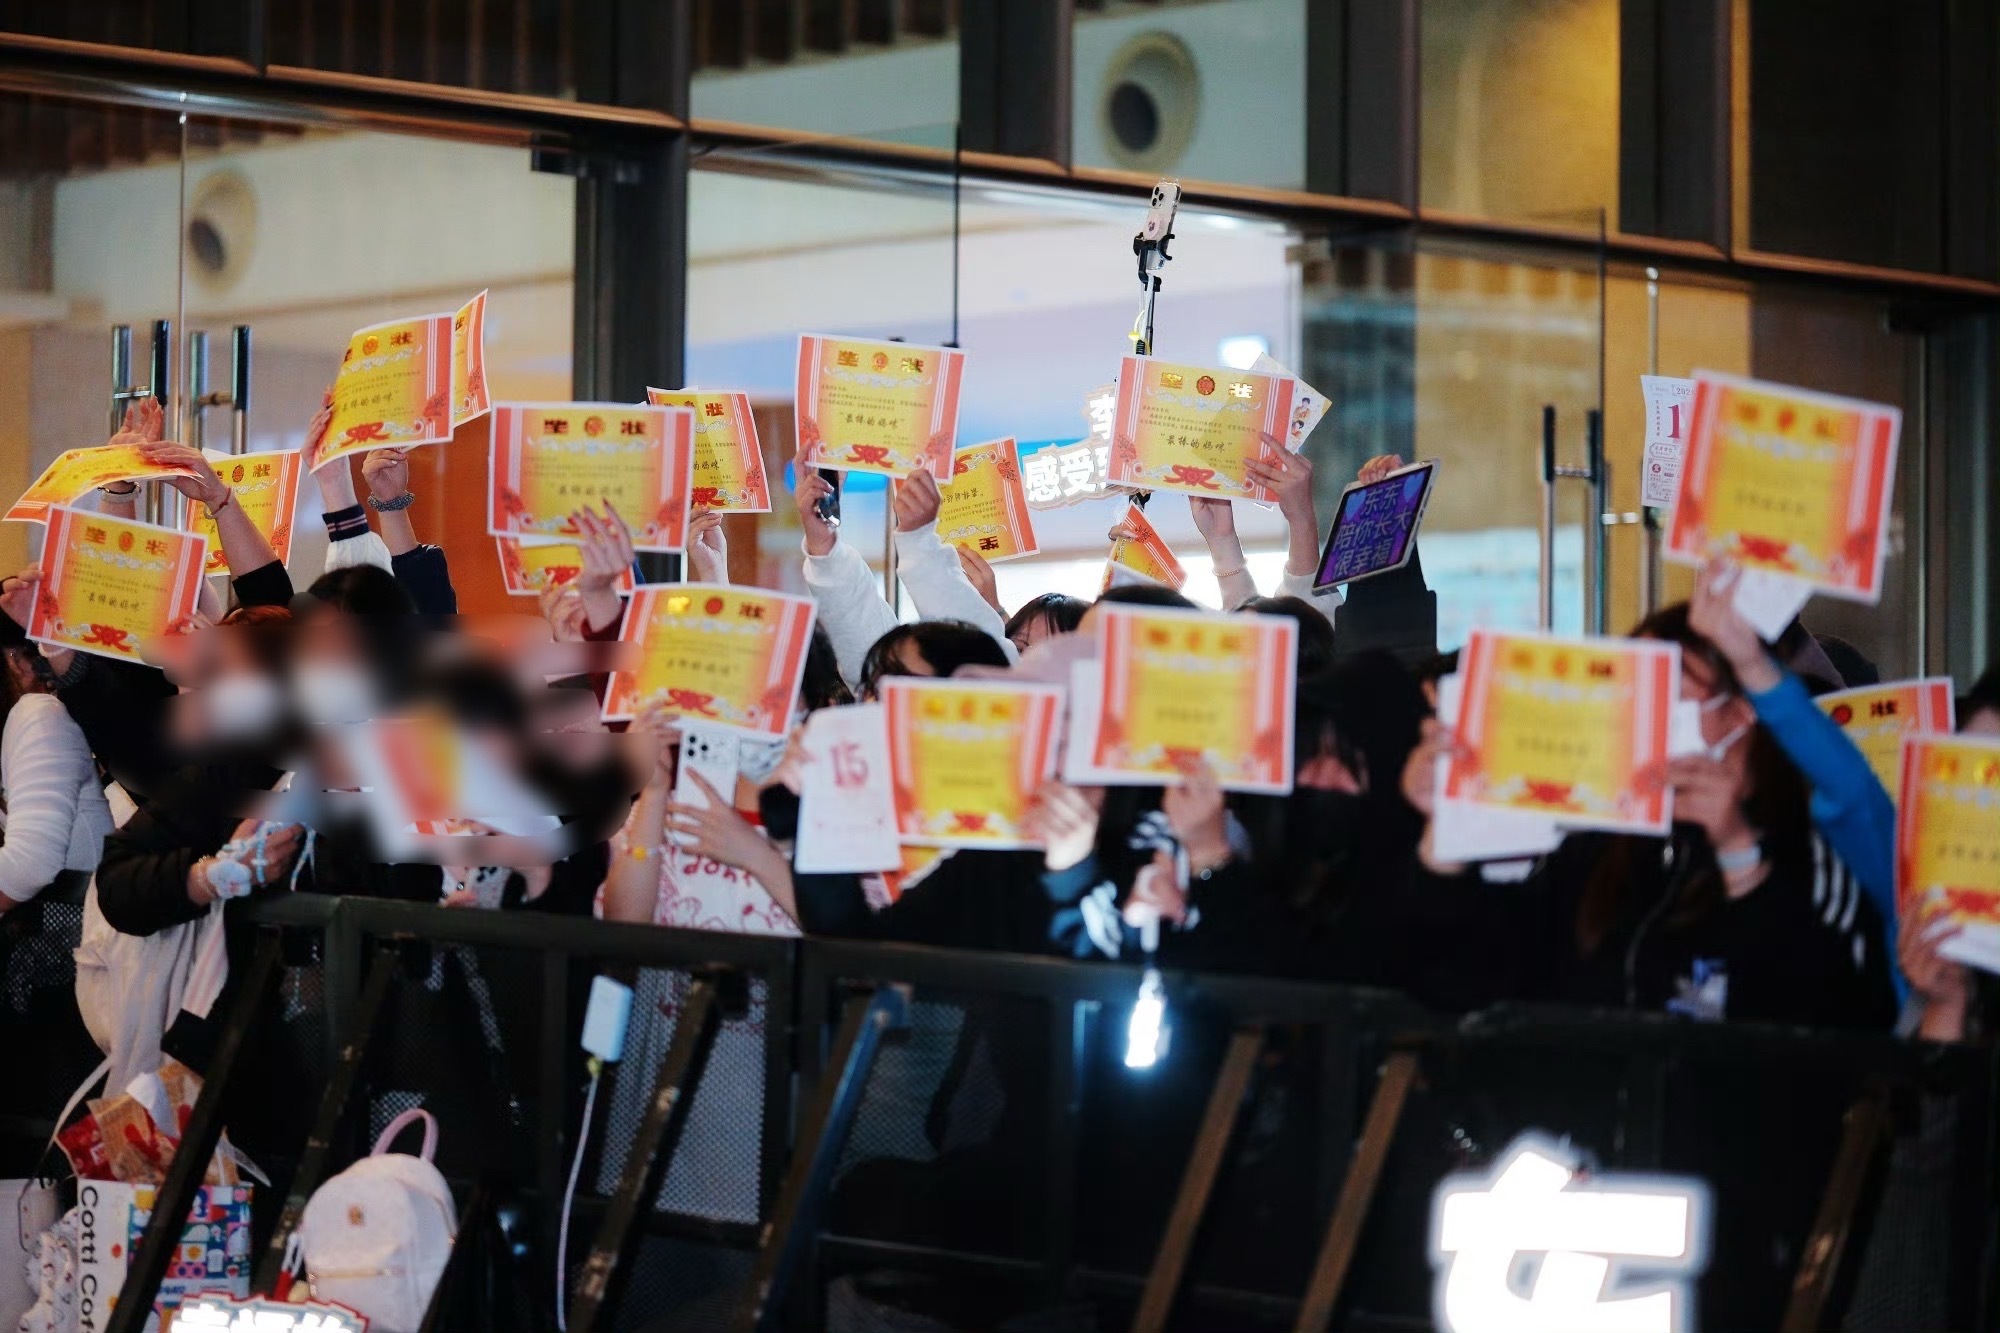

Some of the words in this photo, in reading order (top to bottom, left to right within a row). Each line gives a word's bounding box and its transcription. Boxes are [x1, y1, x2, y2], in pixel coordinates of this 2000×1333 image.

[1675, 386, 1693, 395] 202
[1667, 404, 1681, 439] 1
[1360, 483, 1403, 515] 东东
[1333, 507, 1413, 551] 陪你长大
[1332, 537, 1394, 580] 很幸福
[830, 742, 869, 788] 15
[81, 1186, 98, 1263] Cotti
[81, 1274, 97, 1333] Cof
